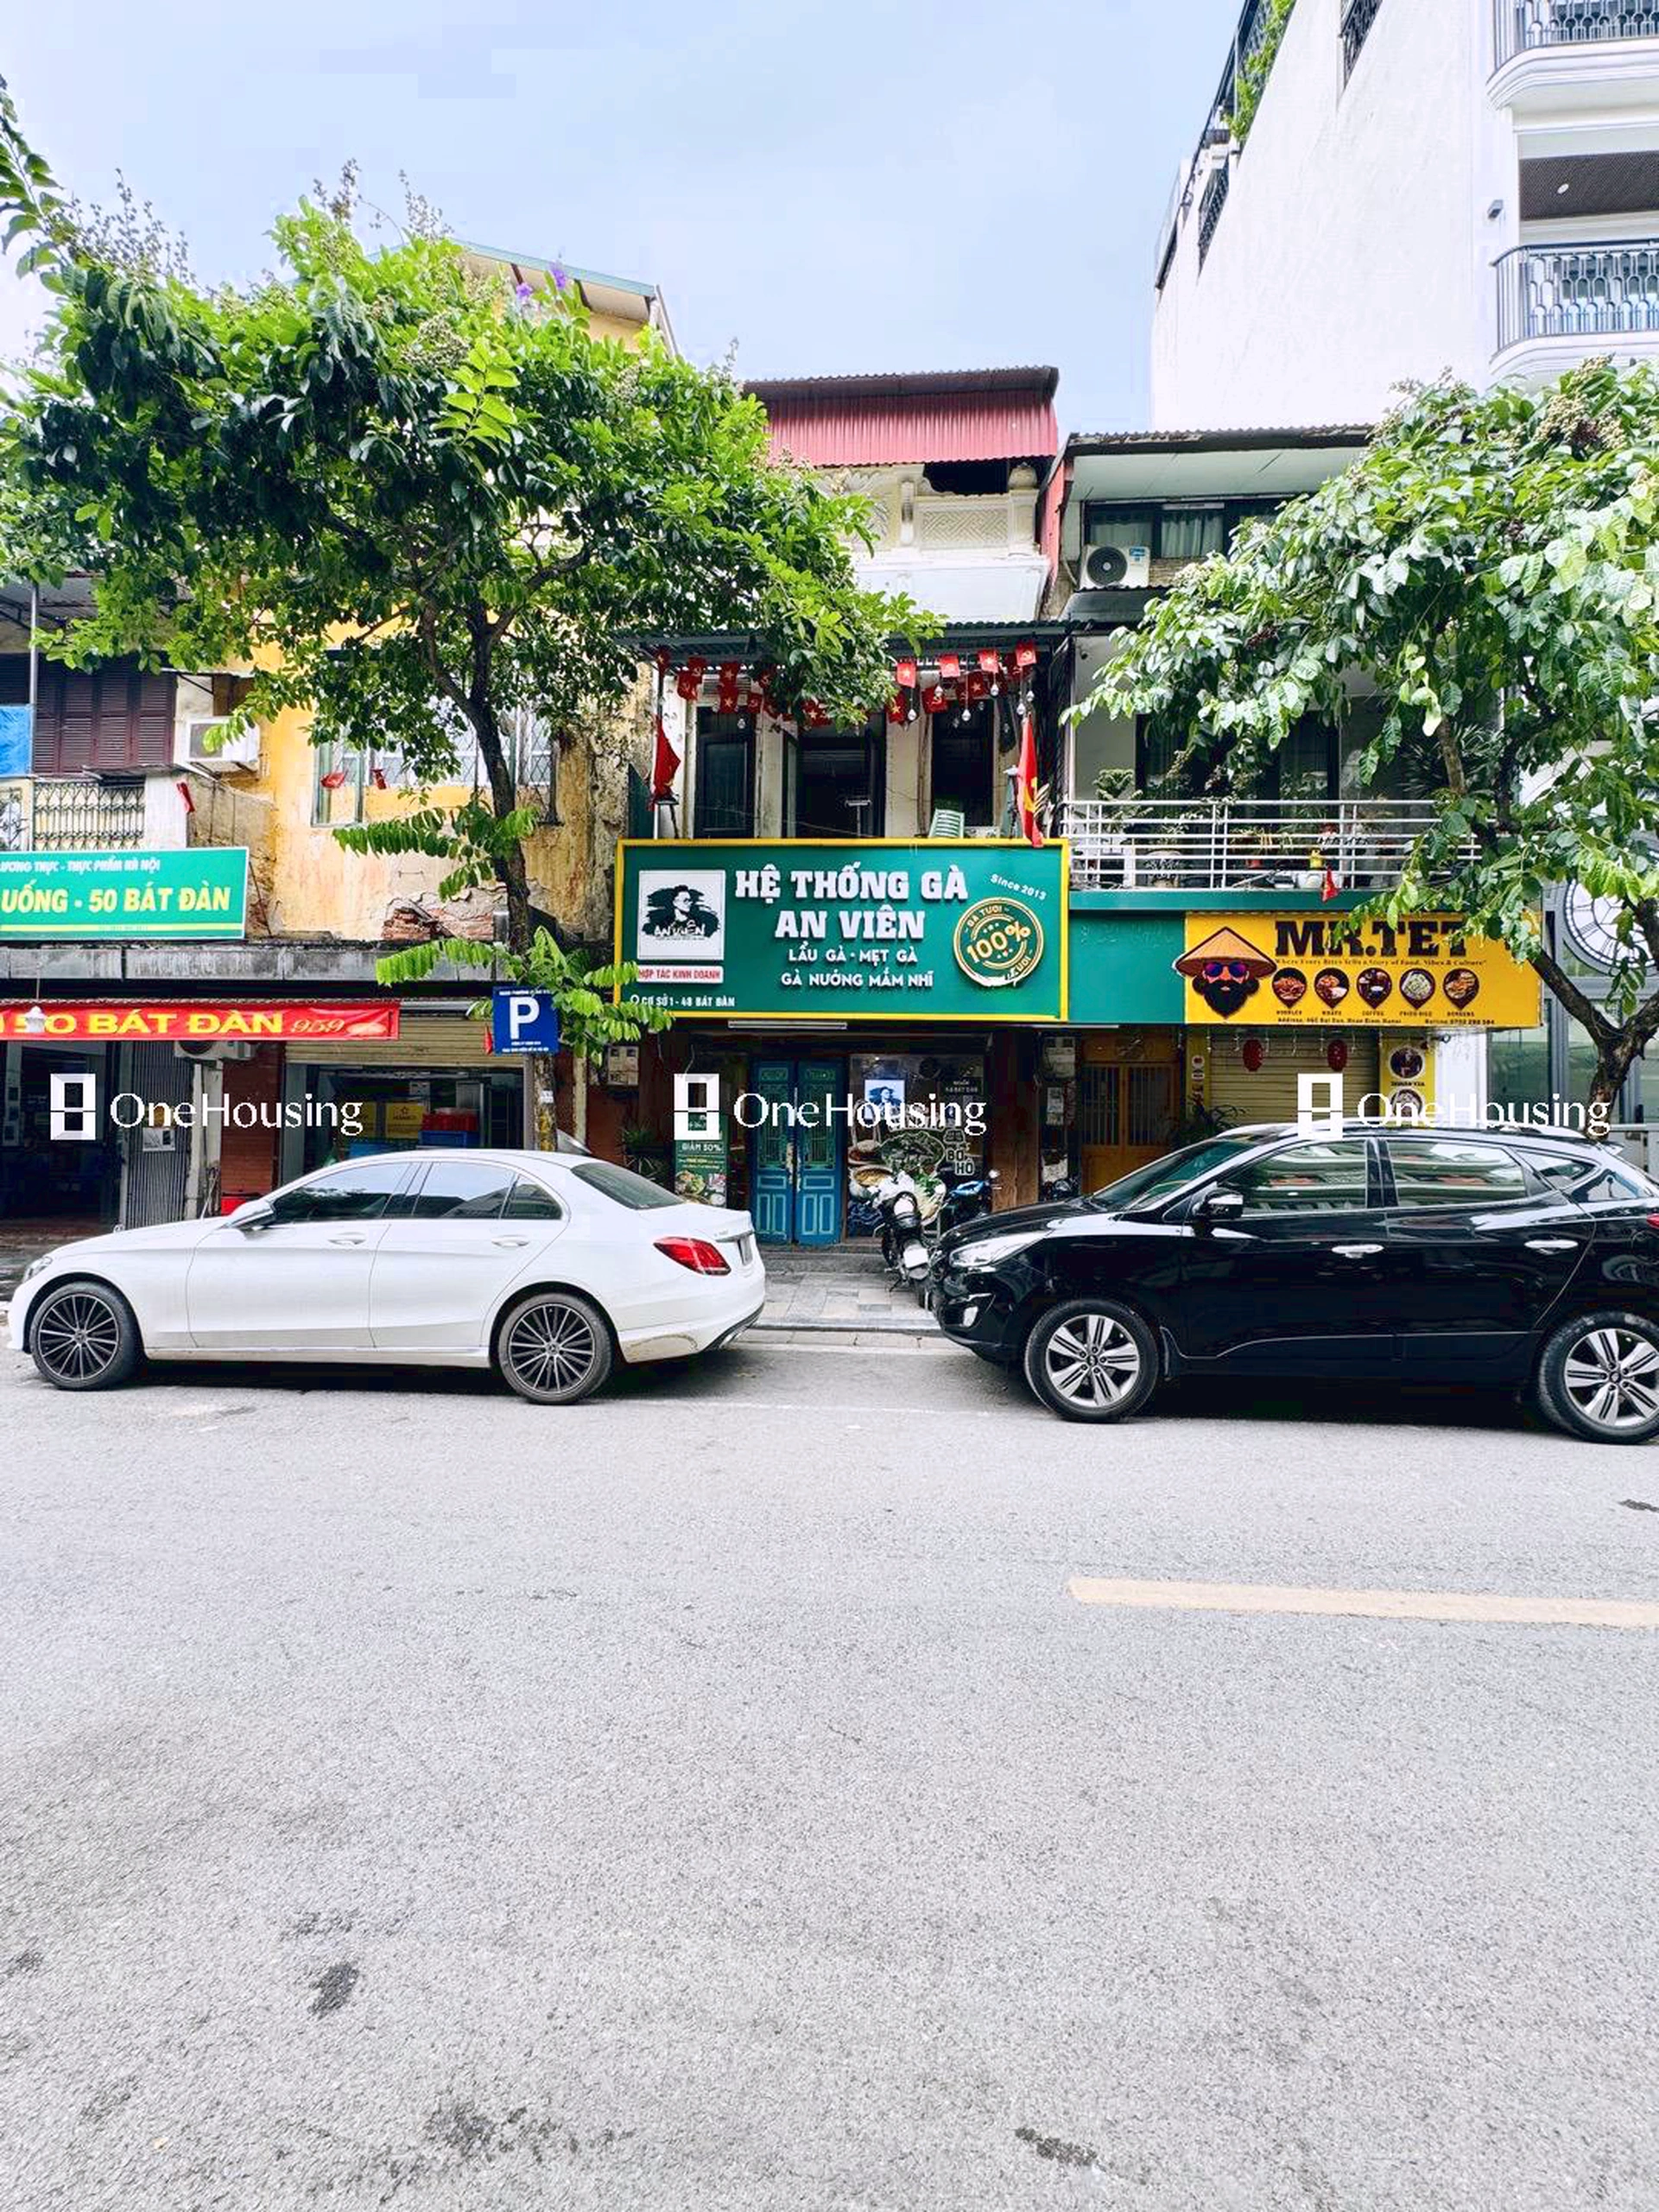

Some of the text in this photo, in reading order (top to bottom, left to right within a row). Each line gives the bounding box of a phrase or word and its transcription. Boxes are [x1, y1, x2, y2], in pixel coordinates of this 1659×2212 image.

[0, 859, 33, 872] ƯƠNG
[735, 861, 969, 903] HỆ THỐNG GÀ
[990, 873, 1048, 900] Since 2013
[1, 878, 69, 913] UỐNG
[88, 889, 118, 913] 50
[123, 881, 174, 911] BÁT
[179, 879, 231, 911] ĐÀN
[775, 904, 925, 939] AN VIÊN
[788, 941, 818, 962] LẨU
[826, 946, 845, 962] GÀ
[859, 949, 889, 967] MẸT
[896, 946, 918, 963] GÀ
[967, 921, 1031, 963] 100%
[656, 968, 671, 979] TÁC
[673, 969, 692, 979] KINH
[693, 969, 720, 979] DOANH
[781, 969, 802, 986] GÀ
[809, 969, 863, 986] NƯỚNG
[695, 995, 713, 1007] BÁT
[88, 1009, 177, 1034] BÁT
[187, 1009, 283, 1034] ĐÀN
[510, 996, 540, 1040] P
